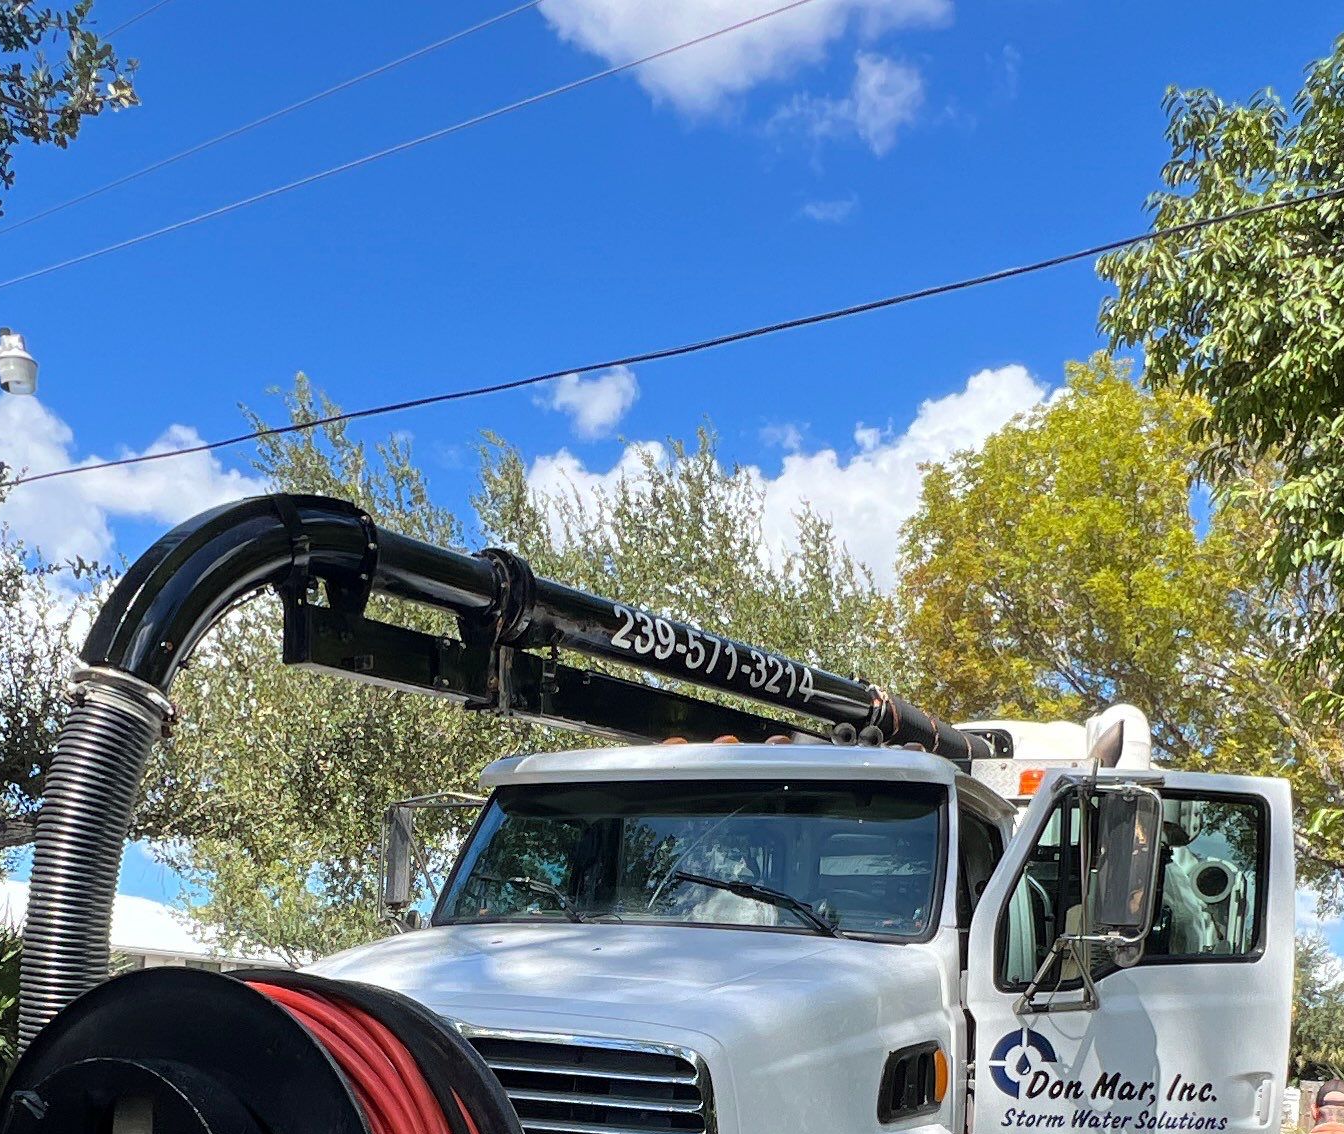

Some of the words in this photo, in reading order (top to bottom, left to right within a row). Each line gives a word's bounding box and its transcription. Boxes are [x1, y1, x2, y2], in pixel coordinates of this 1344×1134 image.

[610, 604, 815, 702] 239-571-3214
[1025, 1070, 1083, 1100] Don
[1090, 1072, 1156, 1107] Mar,
[1167, 1074, 1218, 1102] Inc.
[1001, 1107, 1065, 1128] Storm
[1071, 1110, 1133, 1129] Water
[1135, 1110, 1228, 1130] Solutions
